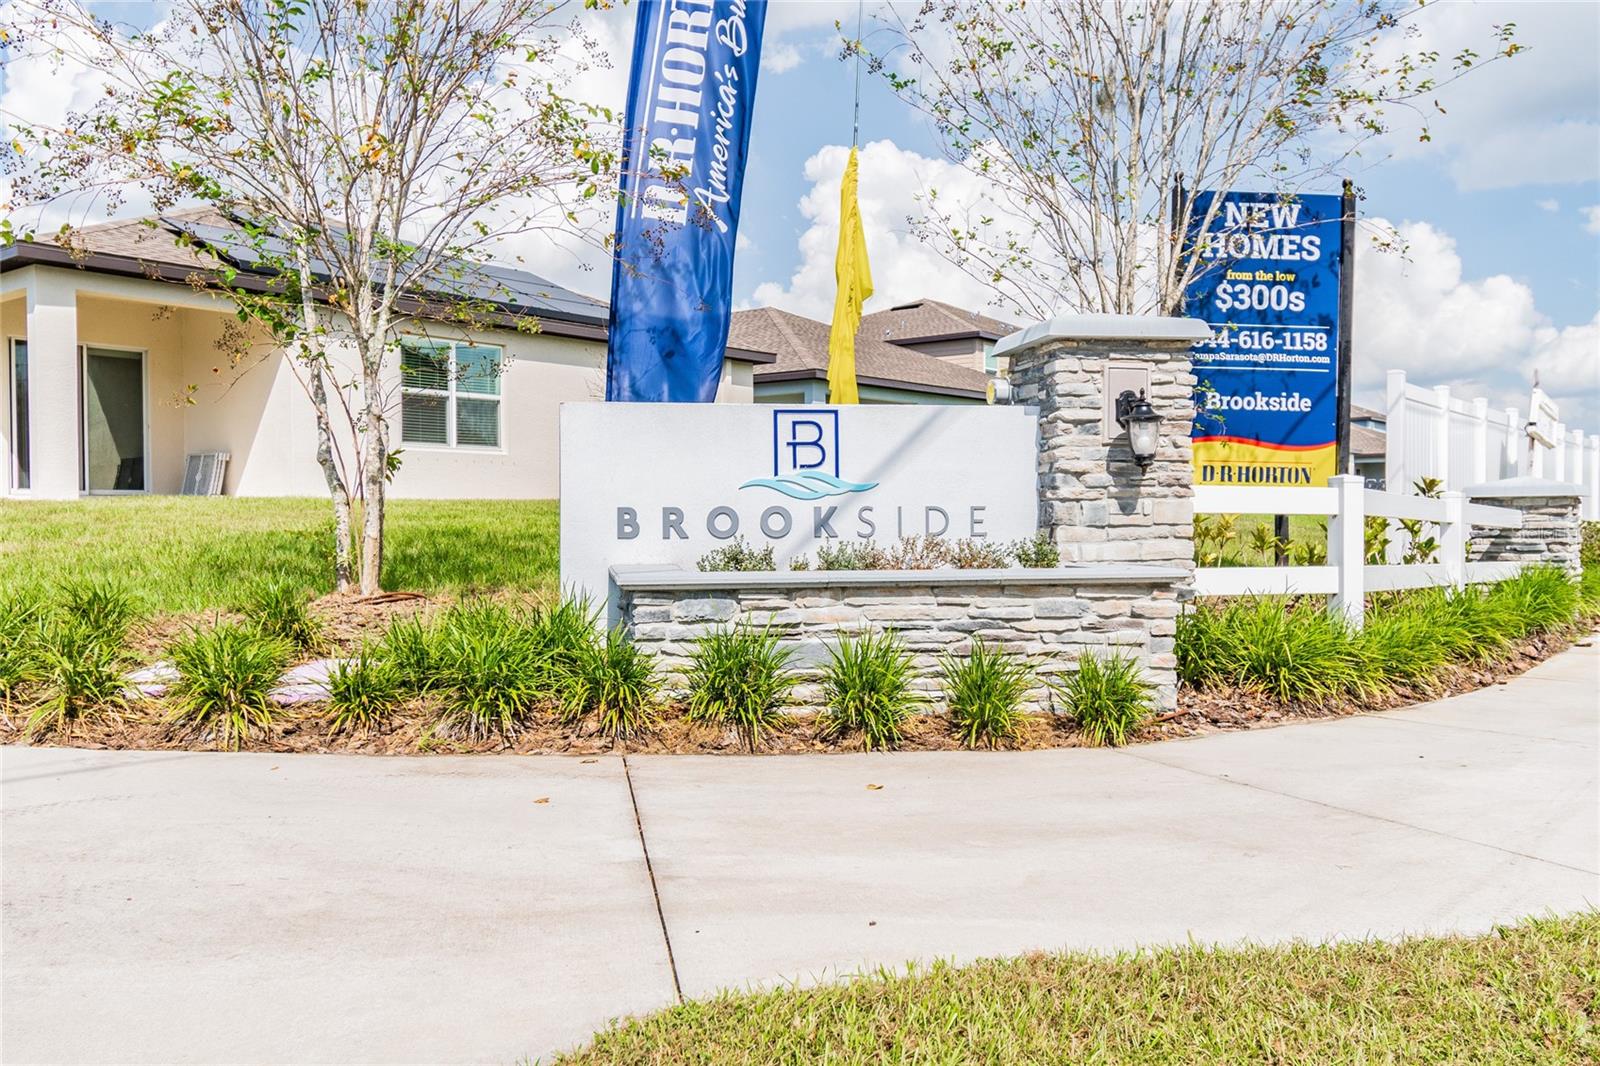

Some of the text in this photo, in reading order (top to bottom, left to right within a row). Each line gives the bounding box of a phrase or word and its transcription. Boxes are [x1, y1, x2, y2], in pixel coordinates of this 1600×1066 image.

[693, 64, 740, 233] America's
[1224, 202, 1302, 228] NEW
[1201, 232, 1321, 262] HOMES
[1226, 269, 1296, 282] from the low
[1215, 280, 1306, 312] $300s
[1192, 352, 1331, 364] ampaSarasota@DRHorton.com
[1205, 391, 1312, 412] Brookside
[786, 419, 827, 470] B
[616, 505, 988, 540] BROOKSIDE
